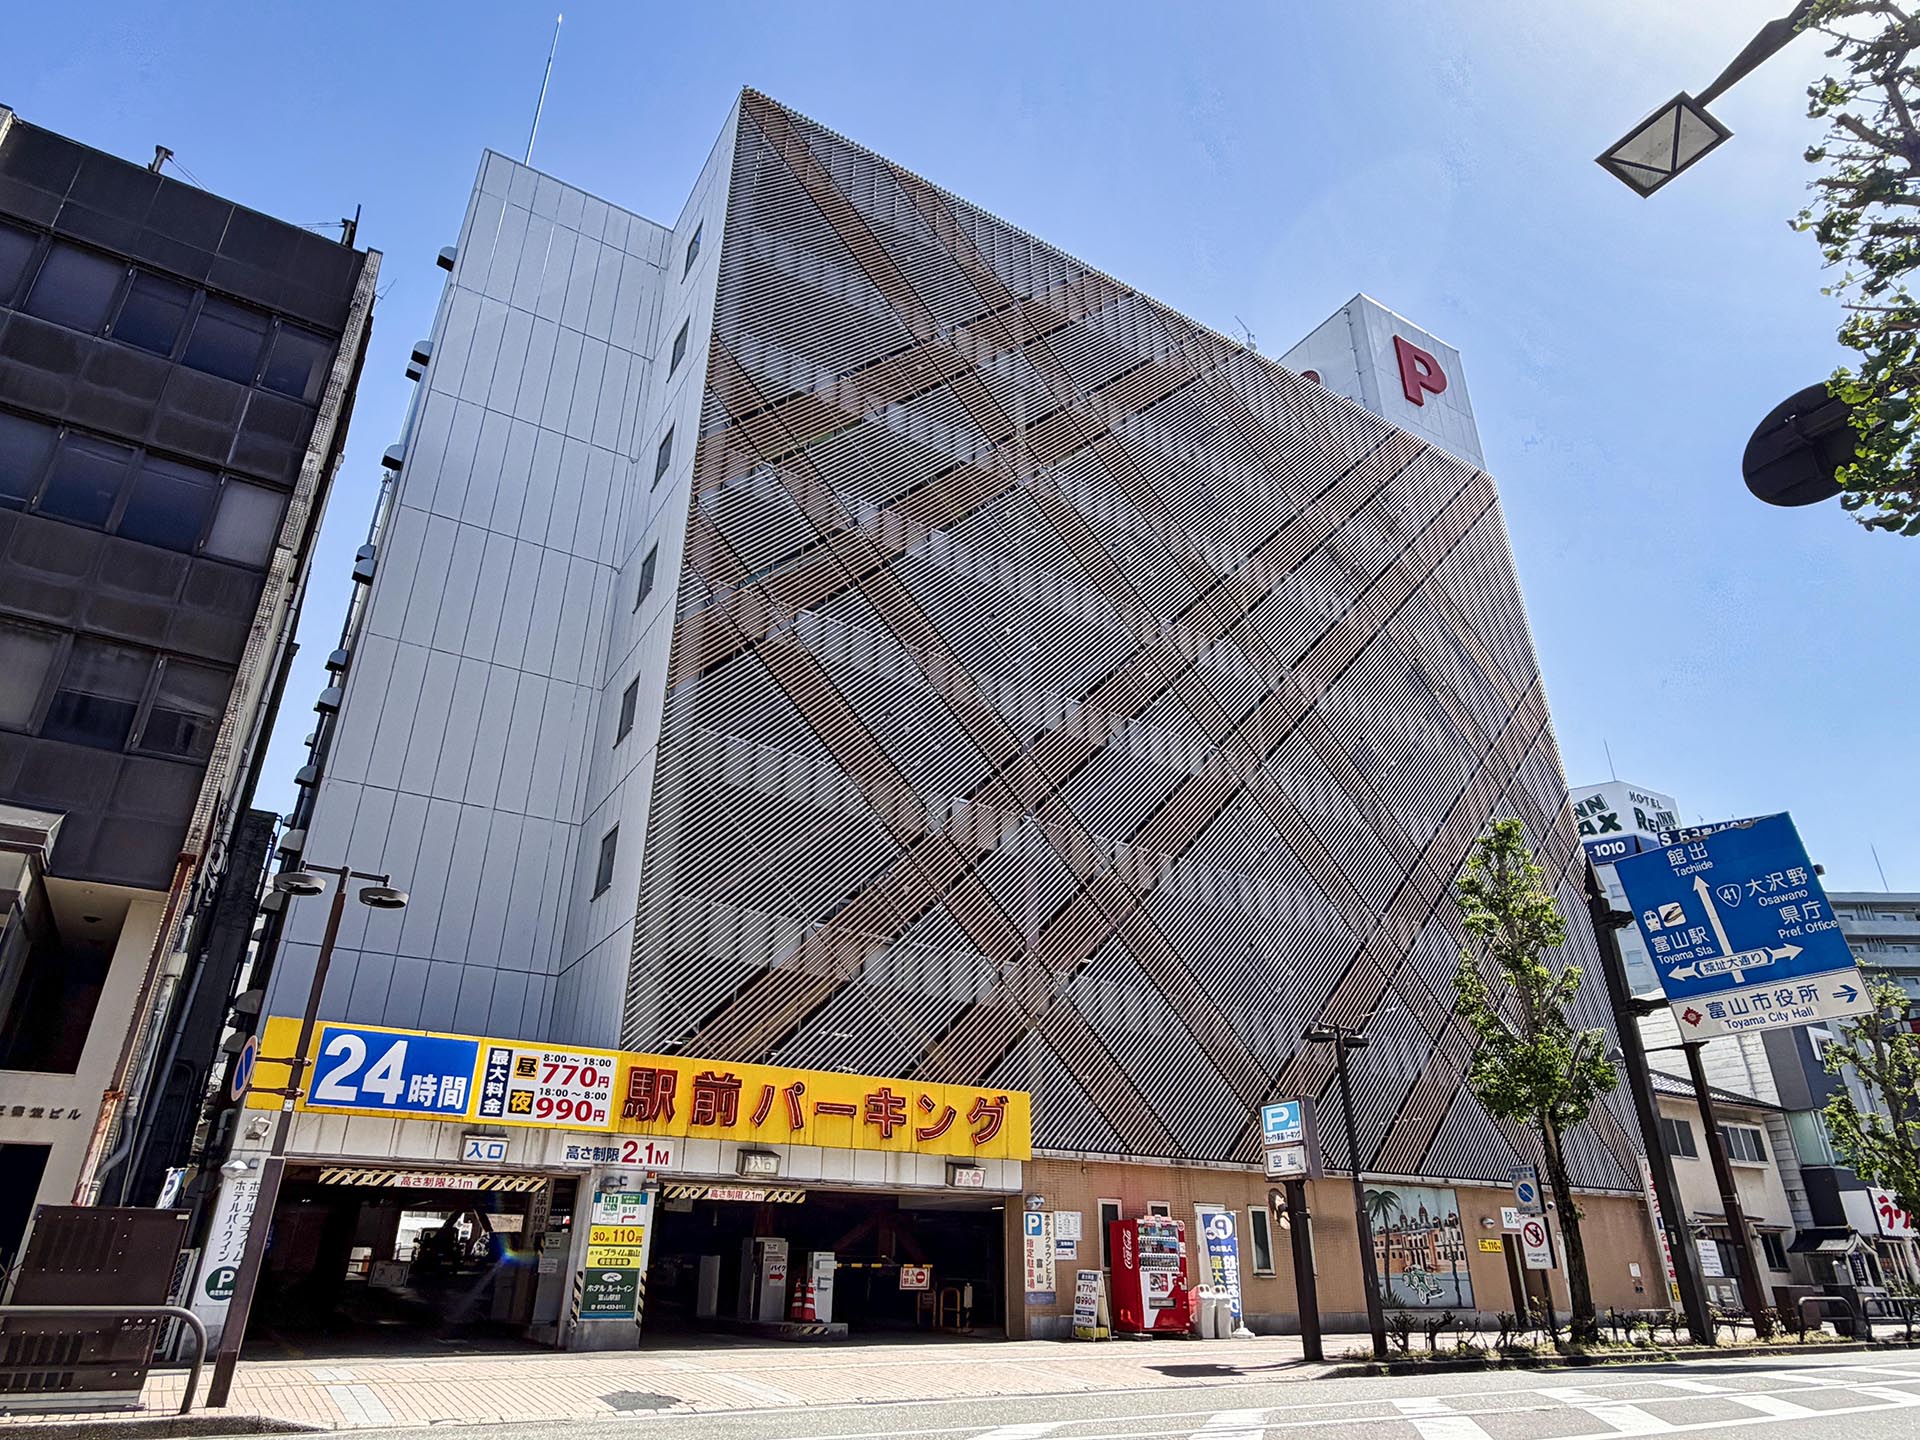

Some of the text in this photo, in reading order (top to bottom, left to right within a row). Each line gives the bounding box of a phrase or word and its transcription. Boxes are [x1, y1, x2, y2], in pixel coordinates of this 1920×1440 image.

[1393, 334, 1447, 407] P
[1629, 791, 1662, 809] HOTEL
[1667, 842, 1708, 866] 館出
[1673, 861, 1713, 878] Tachiide
[1746, 867, 1808, 896] 大沢野
[1723, 889, 1738, 901] 41
[1759, 889, 1808, 906] Osawano
[1779, 900, 1821, 925] 県庁
[1651, 926, 1710, 953] 富山駅
[1778, 920, 1839, 939] Pref. Office
[1657, 947, 1715, 965] Toyama Sta.
[1706, 983, 1820, 1019] 富山市役所
[1725, 1007, 1814, 1030] Toyama City Hall
[516, 1057, 537, 1077] 昼
[544, 1054, 567, 1063] 8:00
[584, 1057, 611, 1067] 18:00
[315, 1034, 467, 1110] 24時間
[483, 1050, 509, 1114] 最大料金
[542, 1063, 610, 1088] 770円
[511, 1091, 533, 1112] 夜
[540, 1087, 568, 1097] 18:00
[584, 1092, 607, 1100] 8:00
[535, 1097, 605, 1122] 990円
[622, 1066, 1010, 1146] 駅前パーキング
[1266, 1107, 1289, 1130] P
[467, 1142, 504, 1159] 入口
[753, 1161, 771, 1170] 入口
[1028, 1214, 1039, 1234] P
[1026, 1239, 1035, 1289] 指定駐車場
[217, 1270, 235, 1288] P
